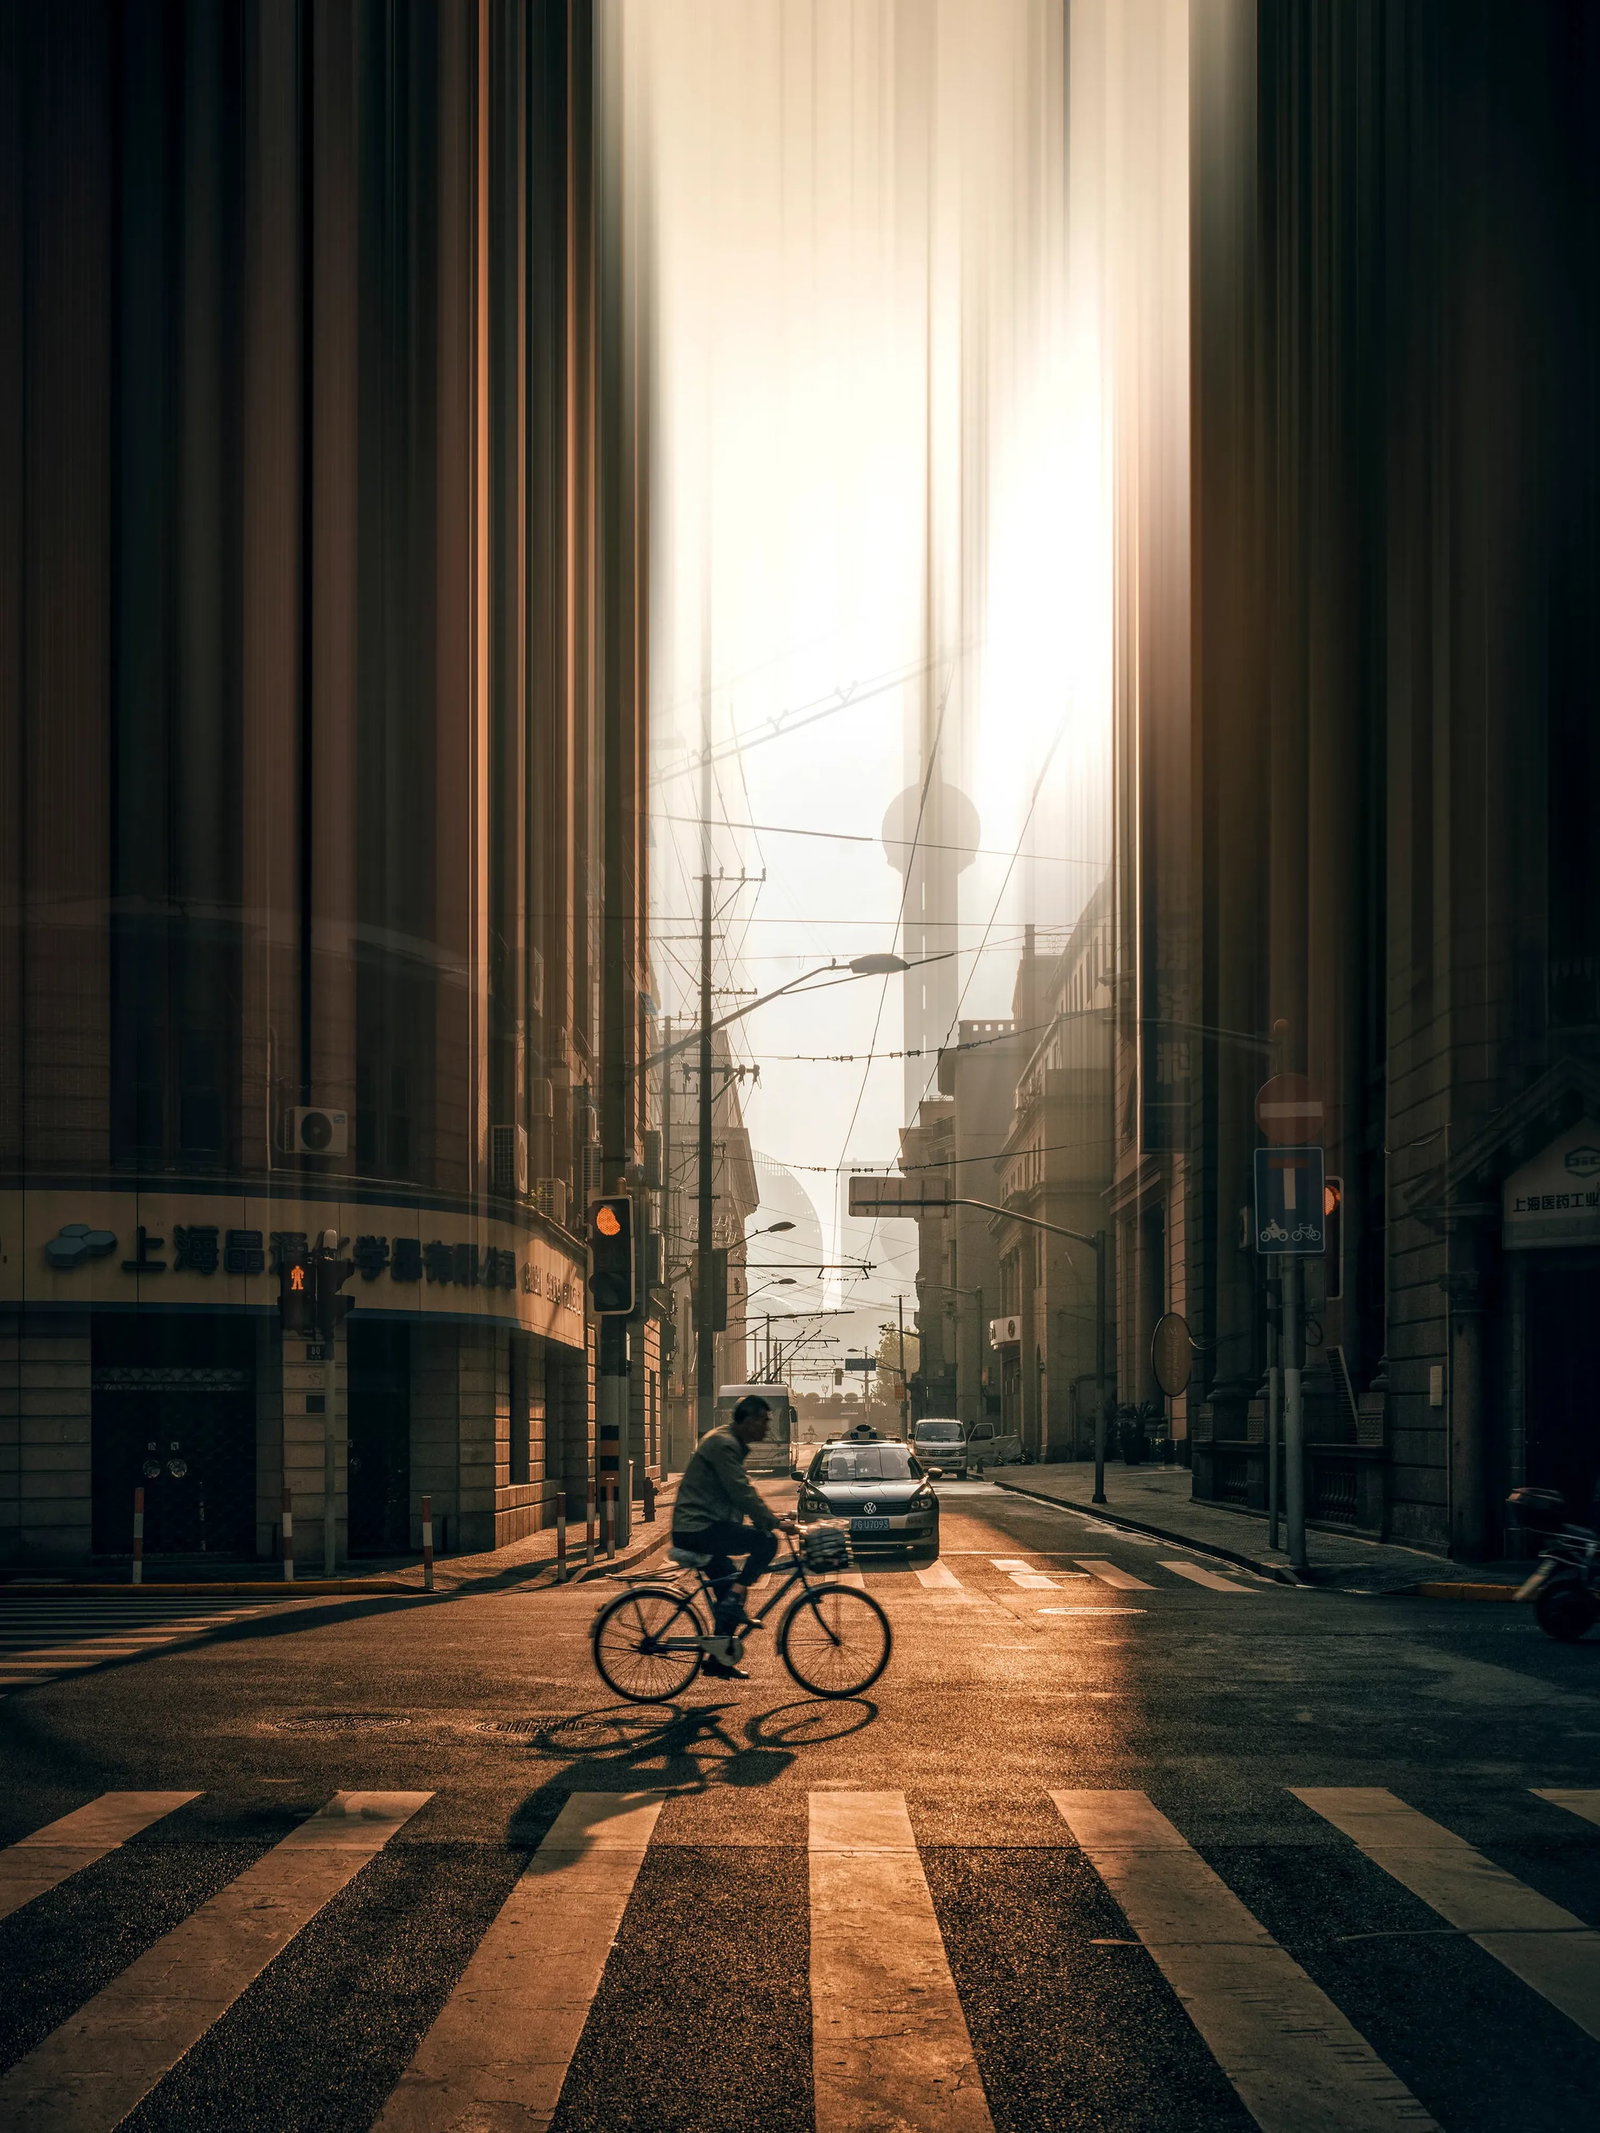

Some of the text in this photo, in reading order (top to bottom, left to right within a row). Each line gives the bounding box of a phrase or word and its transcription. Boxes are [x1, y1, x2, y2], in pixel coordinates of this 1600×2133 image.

[1513, 1192, 1599, 1213] 上海医药工业
[121, 1225, 517, 1290] 上海晶通学品有限公司
